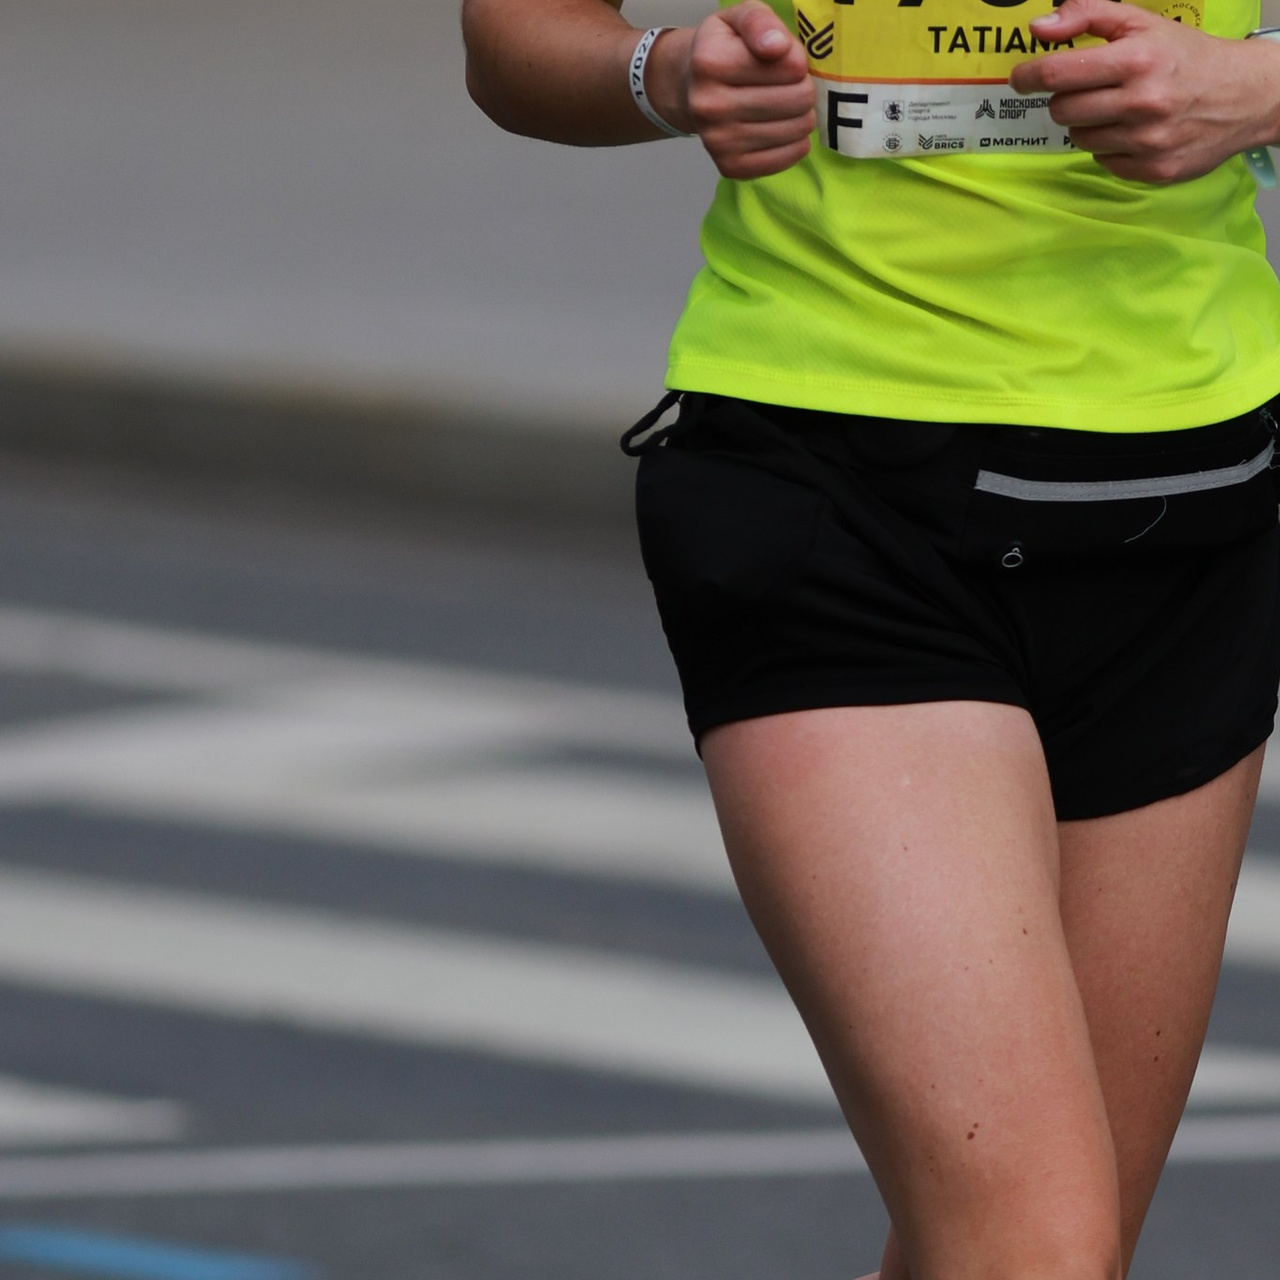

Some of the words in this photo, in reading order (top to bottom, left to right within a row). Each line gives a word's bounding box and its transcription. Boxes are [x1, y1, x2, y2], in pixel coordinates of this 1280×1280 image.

[1172, 2, 1201, 28] МОСКОВСК
[828, 90, 868, 151] F
[999, 109, 1027, 119] СПОРТ
[934, 141, 965, 150] BRICS
